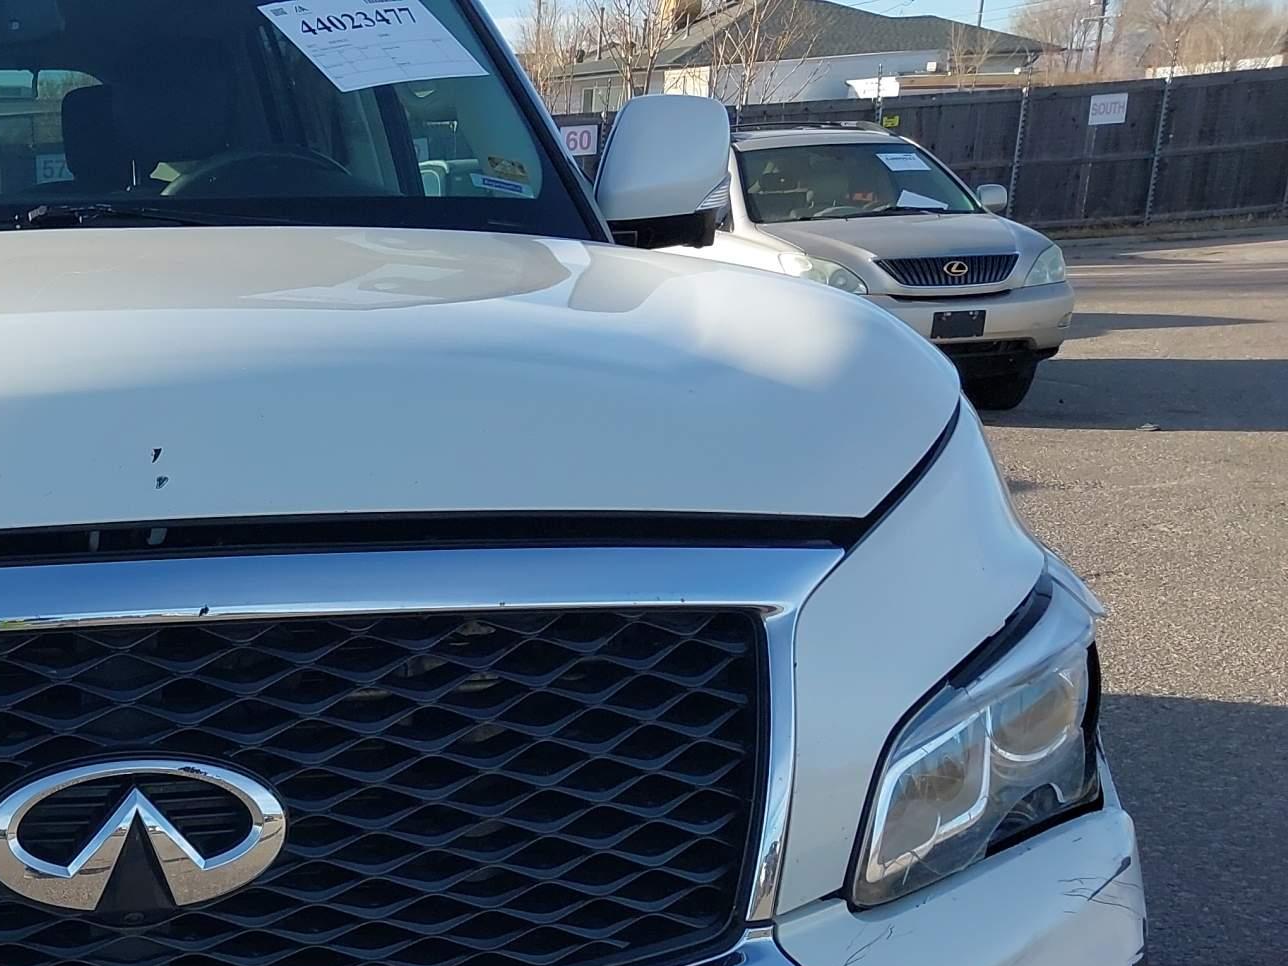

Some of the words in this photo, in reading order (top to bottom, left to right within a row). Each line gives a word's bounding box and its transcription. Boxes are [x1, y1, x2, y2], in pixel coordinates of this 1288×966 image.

[300, 7, 416, 36] 44023477
[1091, 101, 1126, 116] SOUTH
[565, 129, 592, 151] 60
[43, 159, 66, 179] 57
